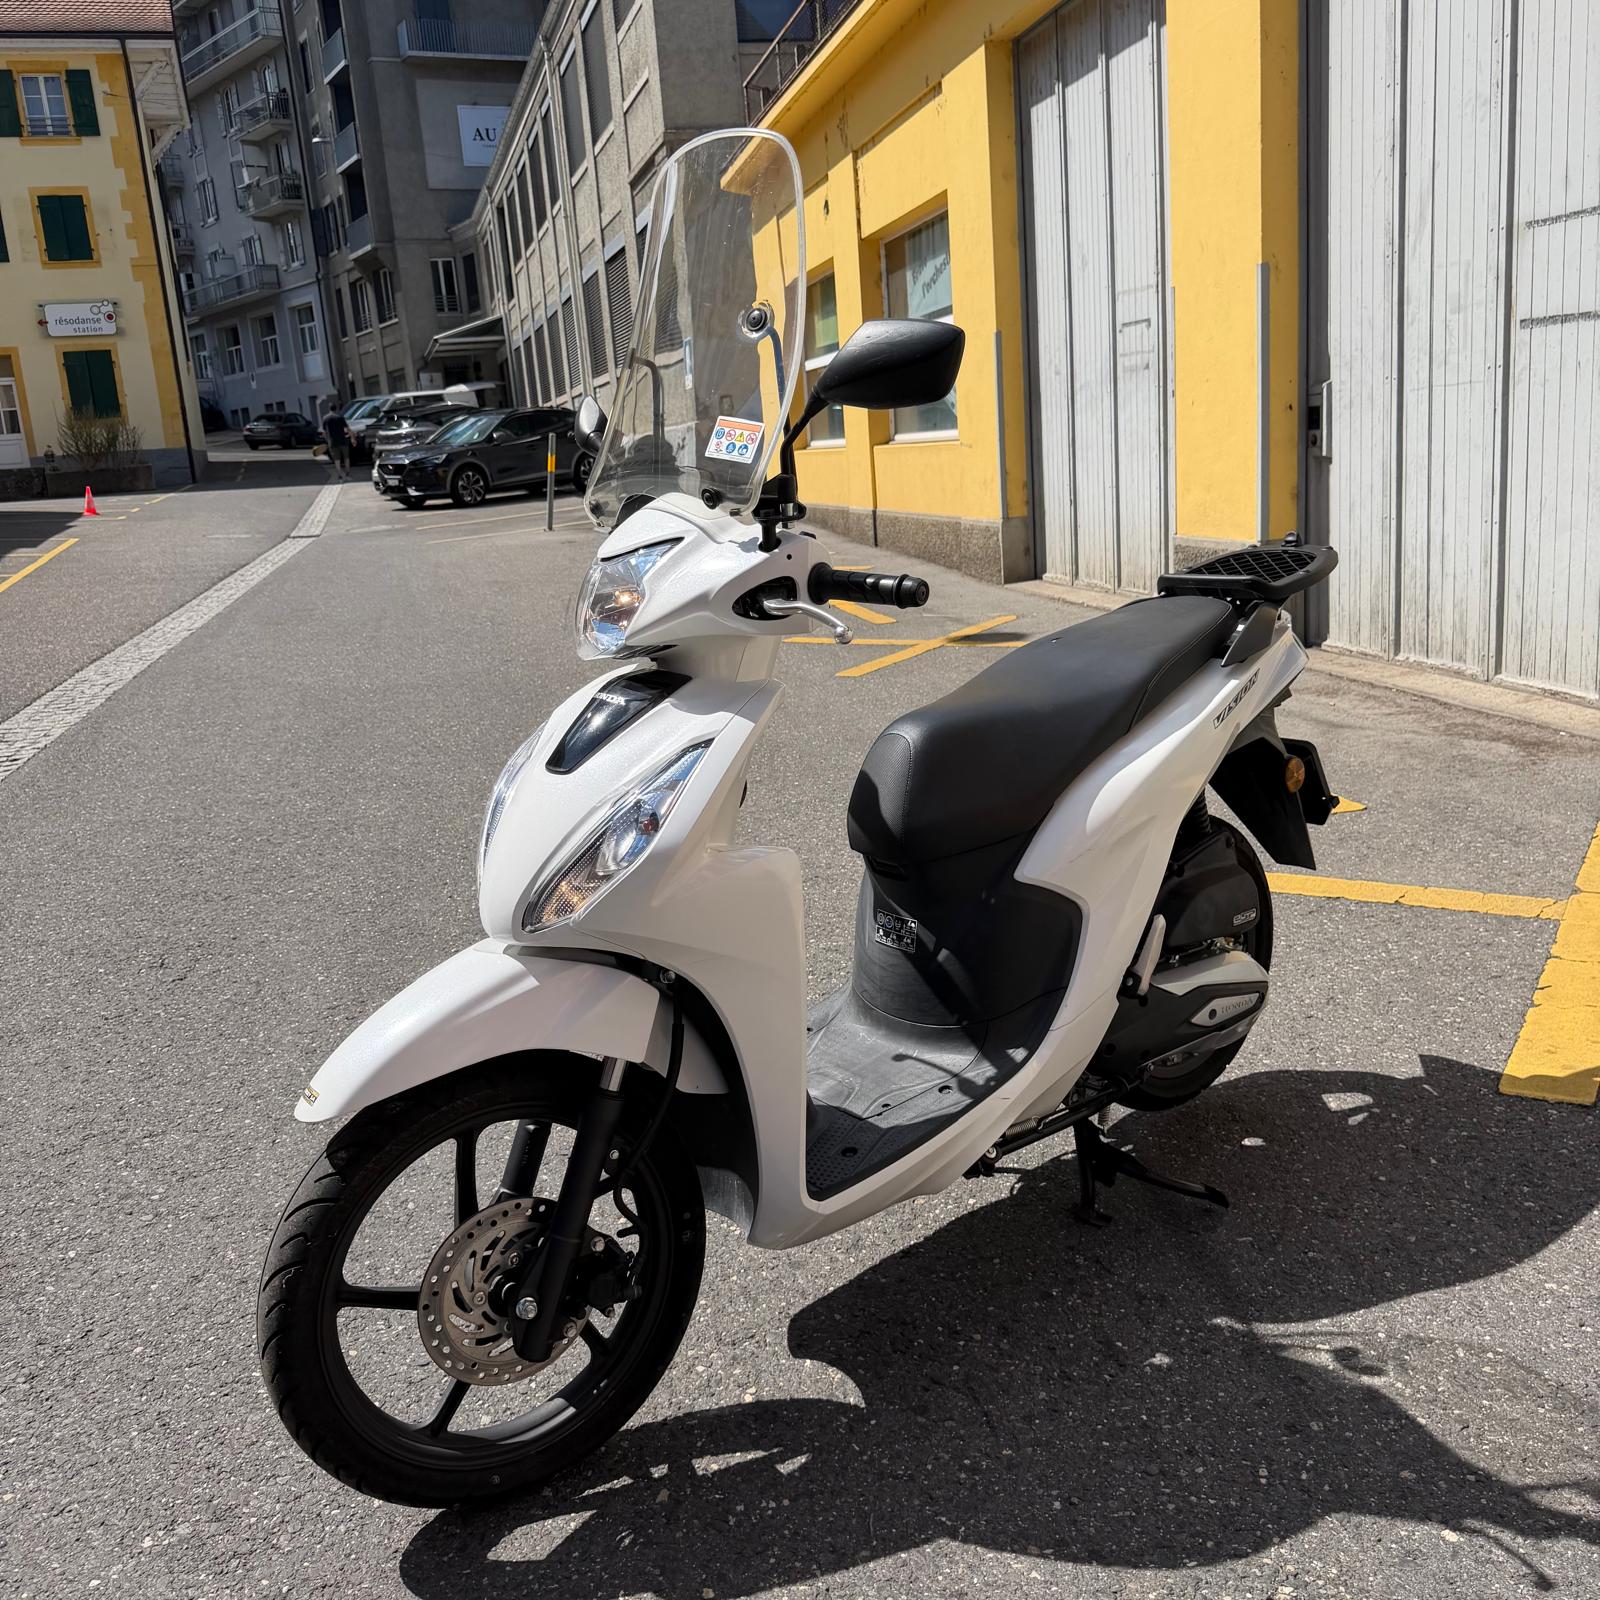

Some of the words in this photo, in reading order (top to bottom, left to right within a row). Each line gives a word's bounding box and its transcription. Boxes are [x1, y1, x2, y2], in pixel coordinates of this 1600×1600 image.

[472, 127, 497, 142] AU
[73, 325, 103, 334] station
[1213, 668, 1260, 729] VISION
